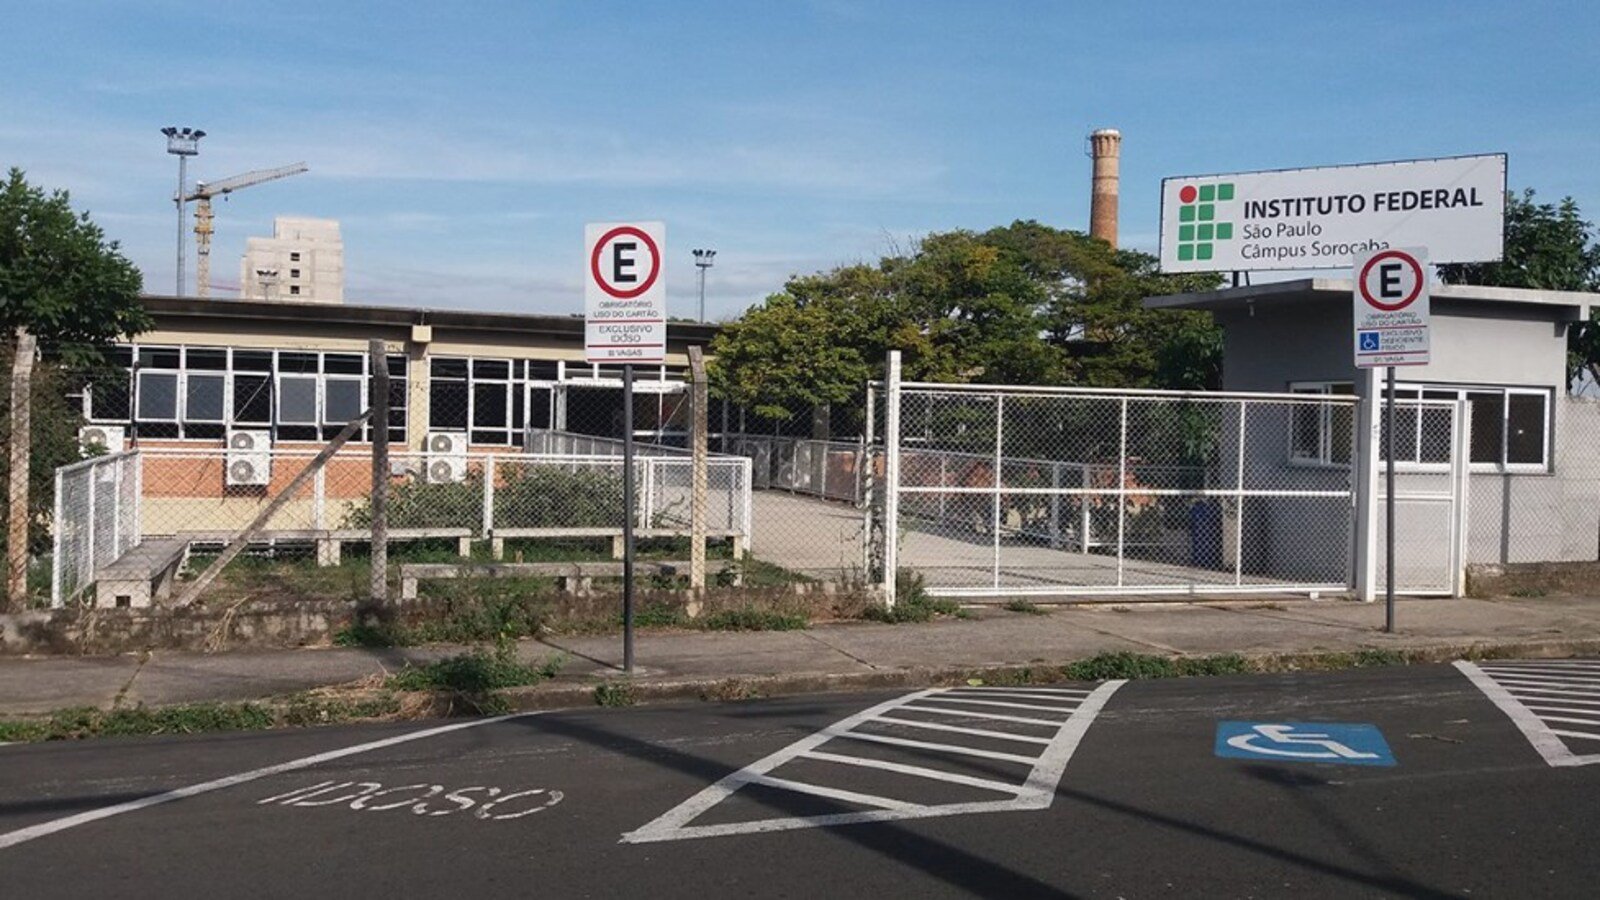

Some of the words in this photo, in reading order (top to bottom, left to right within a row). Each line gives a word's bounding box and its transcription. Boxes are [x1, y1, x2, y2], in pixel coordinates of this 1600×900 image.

[1243, 194, 1366, 219] INSTITUTO
[1373, 187, 1484, 212] FEDERAL
[1242, 223, 1272, 239] São
[1276, 220, 1322, 238] Paulo
[1241, 243, 1307, 262] Câmpus
[613, 242, 637, 283] E
[1380, 263, 1402, 298] E
[625, 310, 659, 318] CARTÃO
[599, 325, 652, 334] EXCLUSIVO
[611, 334, 641, 343] IDOSO
[616, 349, 642, 357] VAGAS
[257, 780, 564, 819] IDOSO
